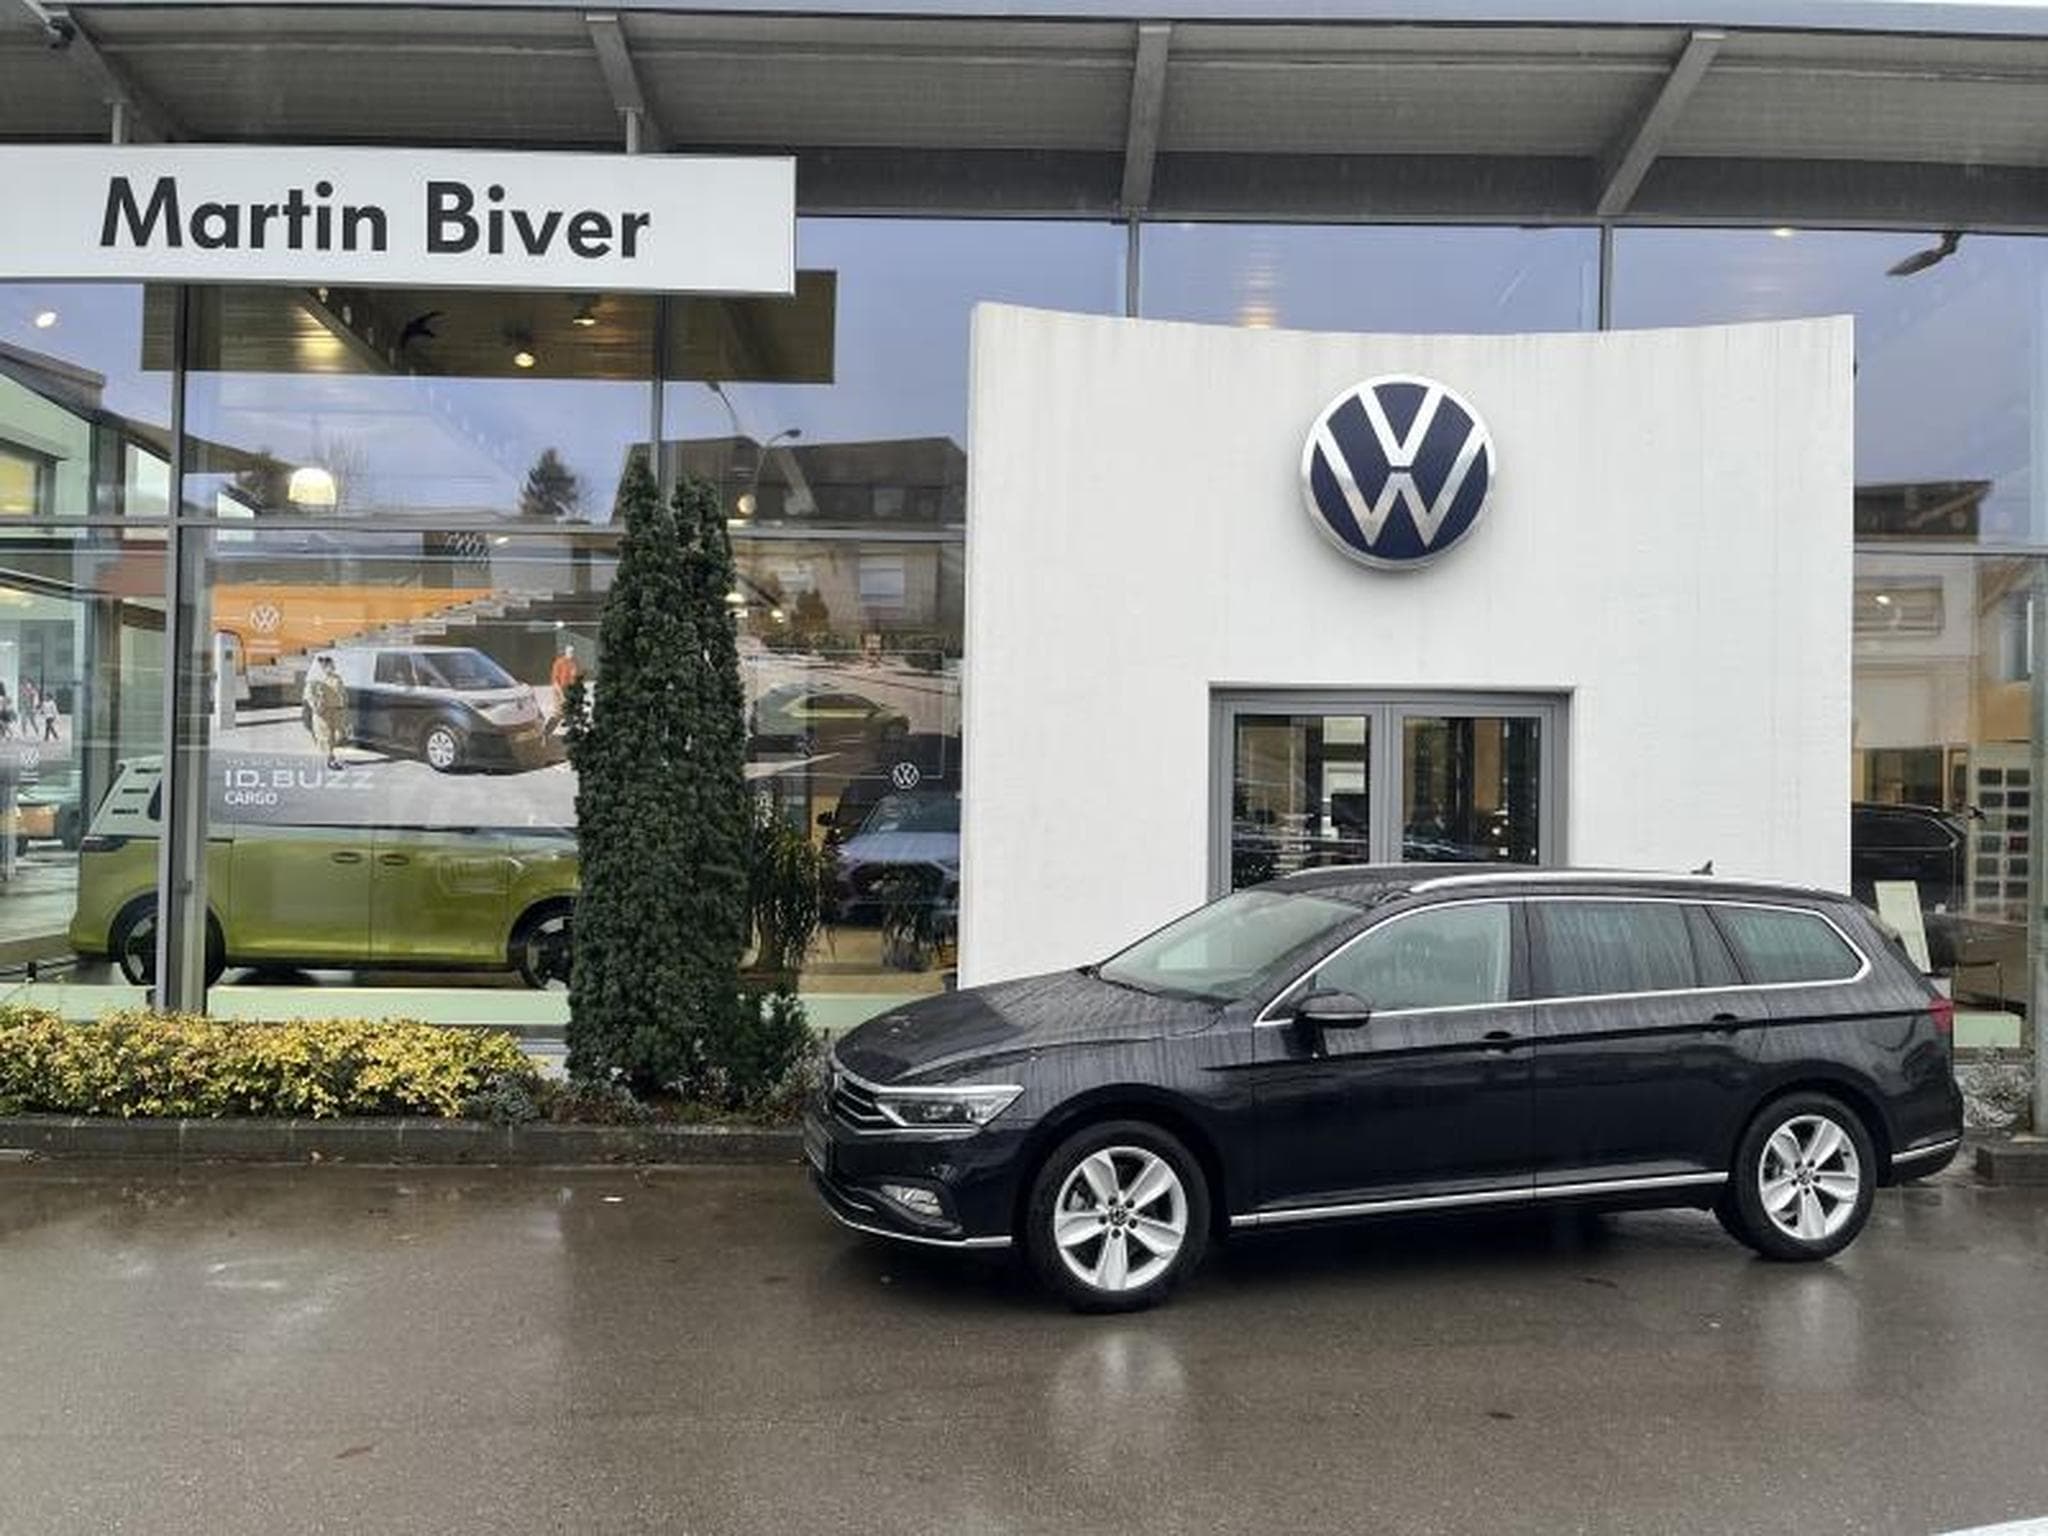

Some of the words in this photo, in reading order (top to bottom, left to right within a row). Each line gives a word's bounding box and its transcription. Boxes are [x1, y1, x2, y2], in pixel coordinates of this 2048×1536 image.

[100, 176, 387, 251] Martin
[426, 181, 650, 259] Biver
[1306, 378, 1493, 562] VW
[224, 790, 278, 805] CARGO
